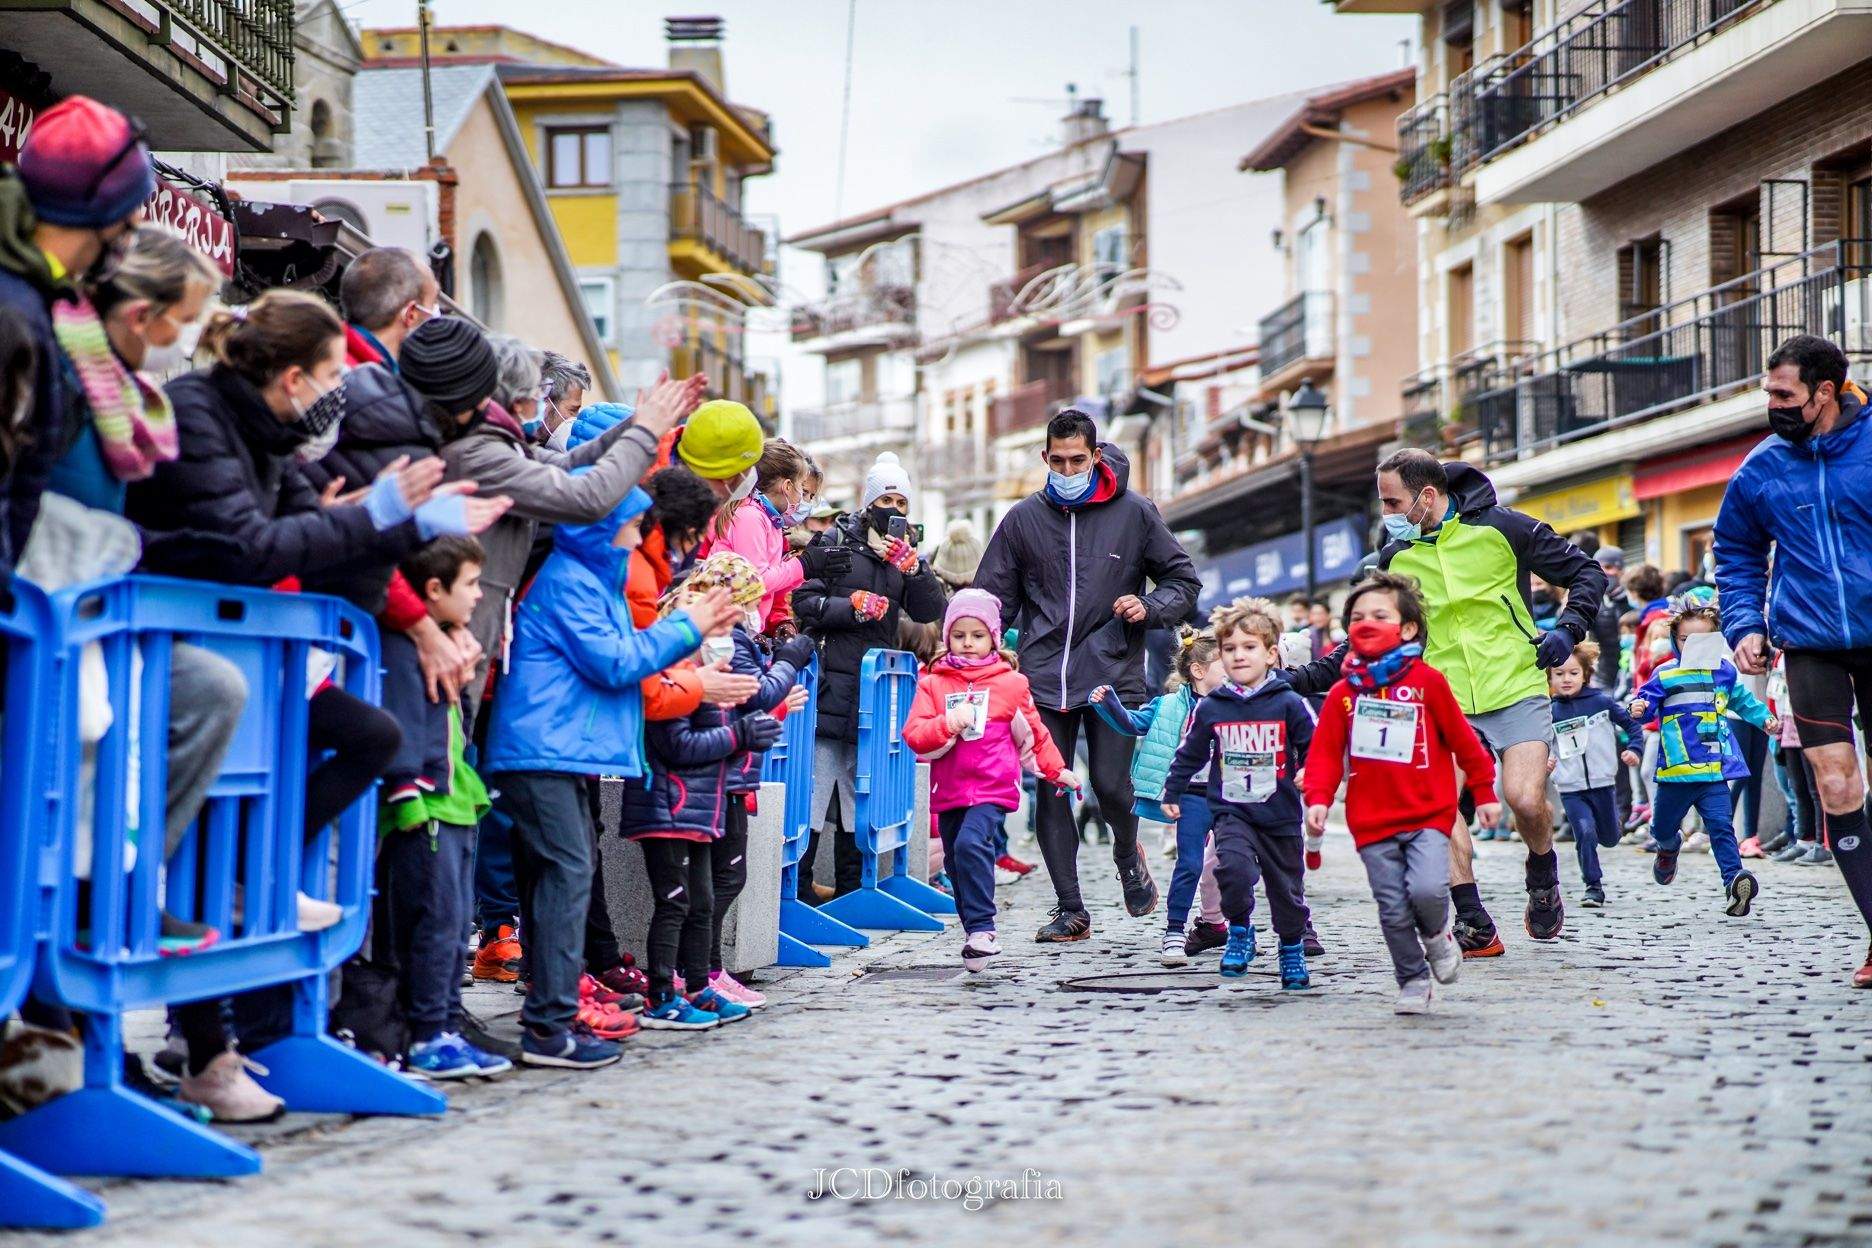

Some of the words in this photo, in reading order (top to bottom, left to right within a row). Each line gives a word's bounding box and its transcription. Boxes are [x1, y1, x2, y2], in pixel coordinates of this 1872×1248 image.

[1214, 722, 1285, 753] MARVEL
[1378, 726, 1388, 747] 1
[1571, 735, 1578, 748] 1
[1243, 774, 1252, 793] 1
